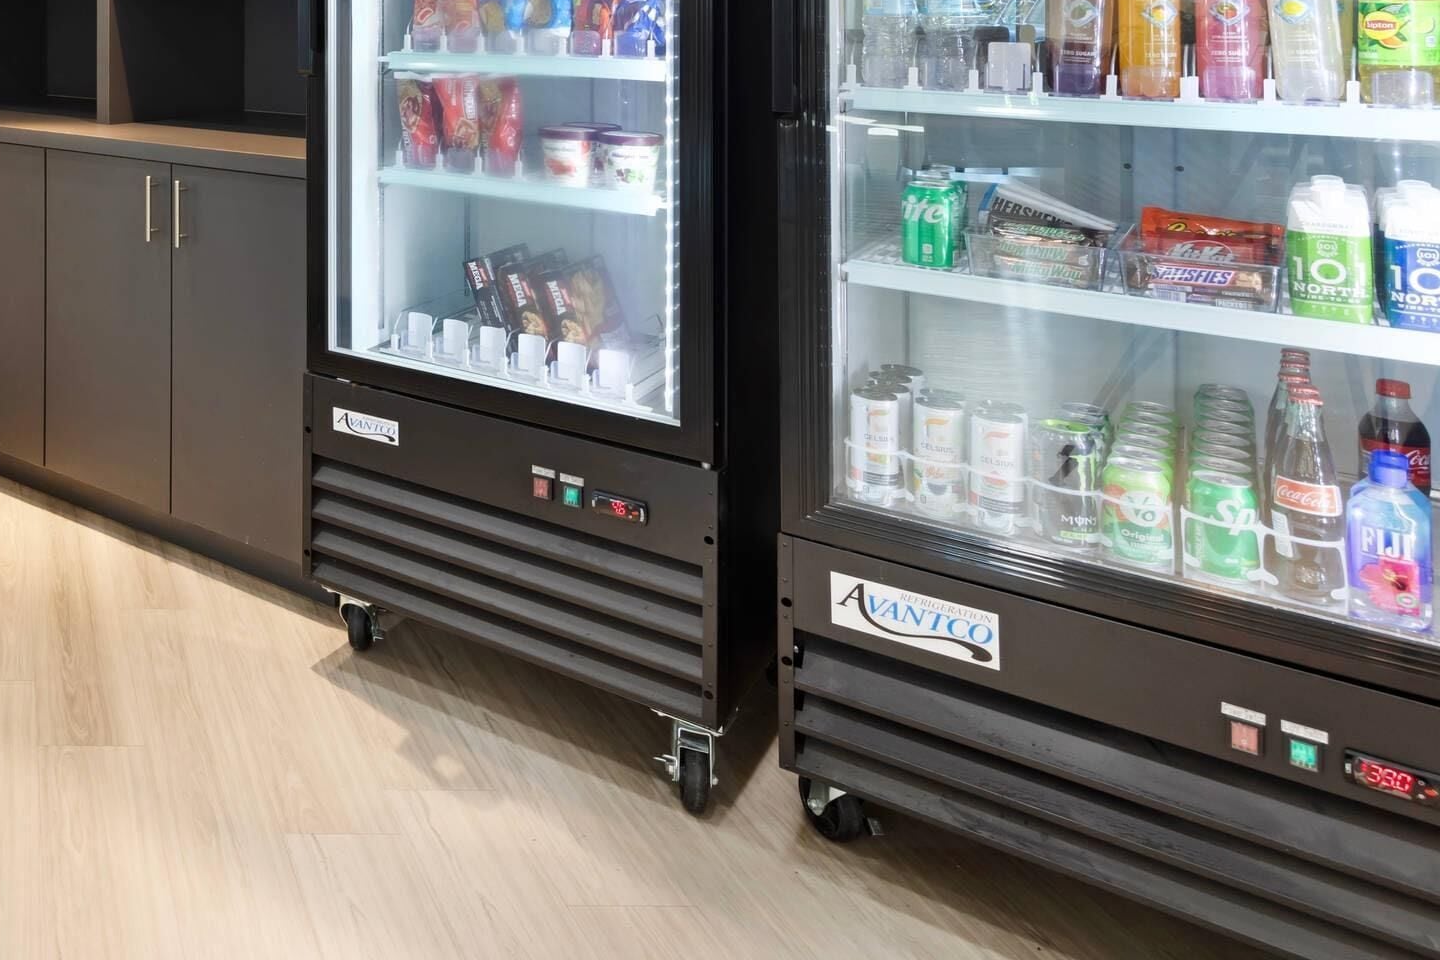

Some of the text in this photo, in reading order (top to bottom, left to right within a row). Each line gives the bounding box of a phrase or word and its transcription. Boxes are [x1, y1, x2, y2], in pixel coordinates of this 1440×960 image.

[467, 261, 484, 290] MEGA
[1151, 266, 1233, 286] SATISFIES
[1293, 257, 1367, 287] 101
[1390, 265, 1440, 296] 10
[507, 273, 528, 308] MEGA
[545, 280, 567, 317] MEGA
[1292, 281, 1369, 299] NORTH
[1391, 291, 1440, 308] NOR
[337, 412, 396, 440] AVANTCO
[1214, 496, 1258, 536] Sp
[1361, 526, 1418, 564] FIJI
[836, 583, 993, 650] AVANTCO
[900, 592, 993, 624] REFRIGERATION
